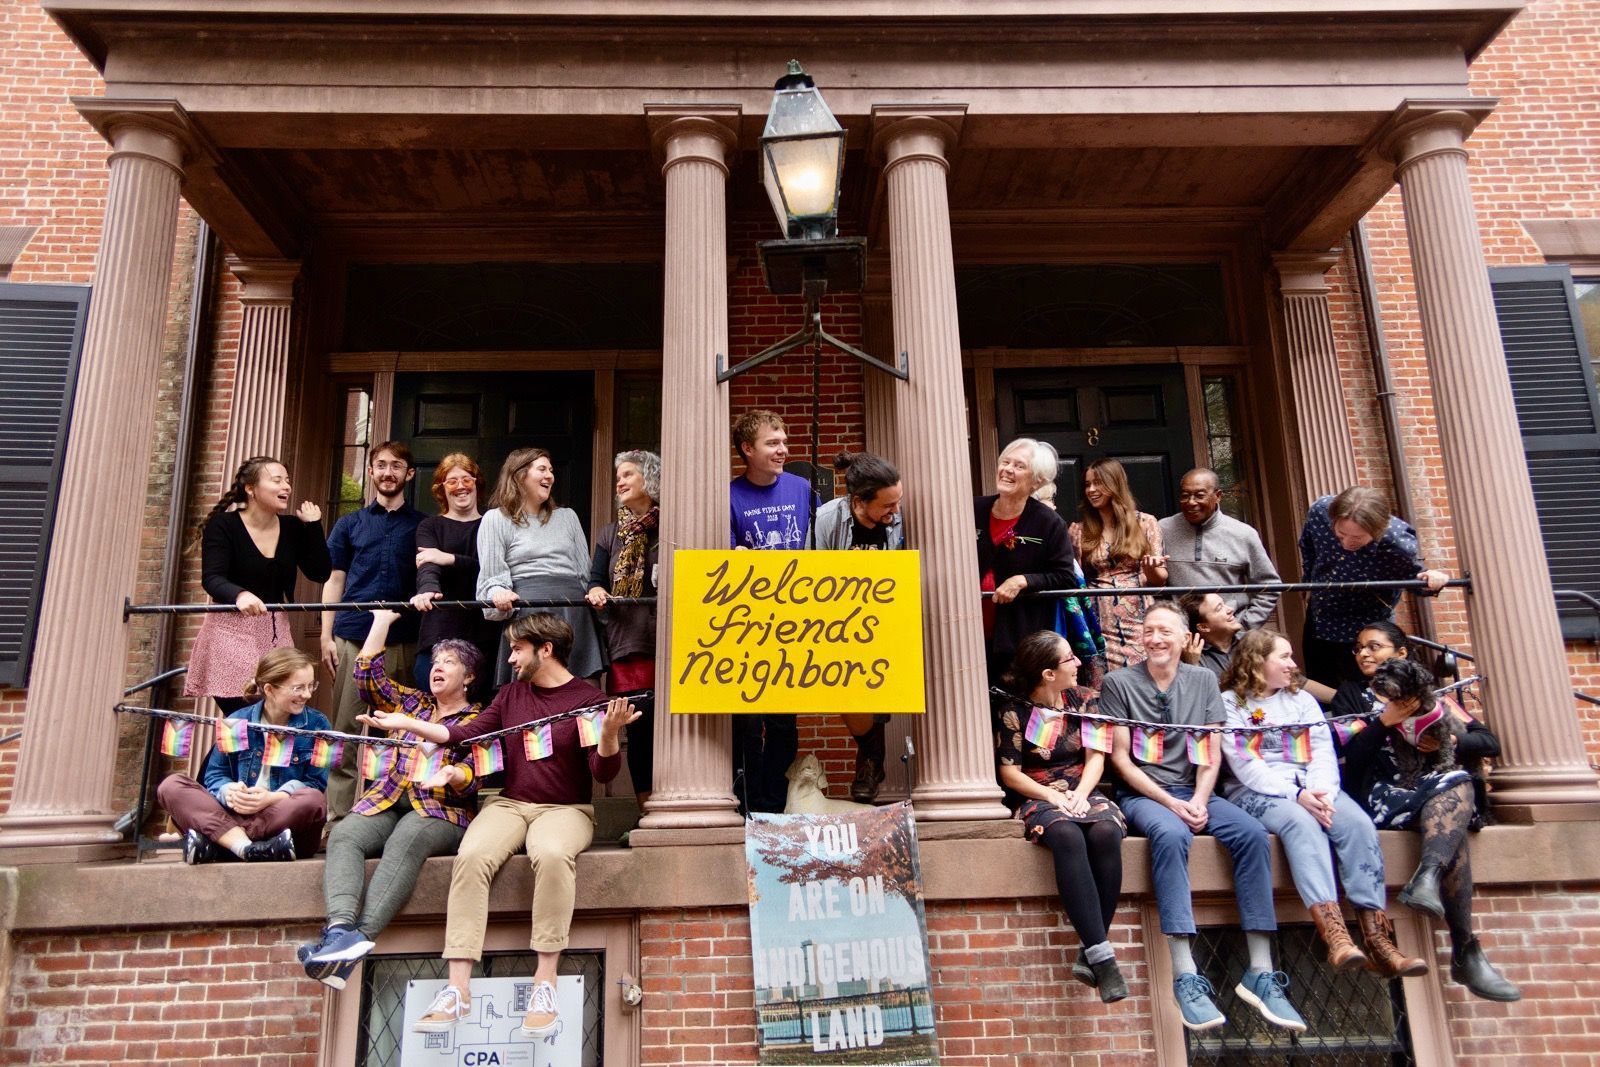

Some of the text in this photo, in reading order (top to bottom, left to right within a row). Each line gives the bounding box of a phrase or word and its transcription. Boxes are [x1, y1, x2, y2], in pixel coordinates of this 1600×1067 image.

[1087, 427, 1099, 447] 8
[703, 559, 895, 606] Welcome
[698, 603, 879, 649] friends
[679, 648, 890, 703] neighbors
[802, 822, 860, 856] YOU
[788, 875, 886, 922] ARE ON
[757, 936, 926, 989] INDIGENOUS
[810, 1005, 884, 1053] LAND
[464, 1052, 500, 1066] CPA
